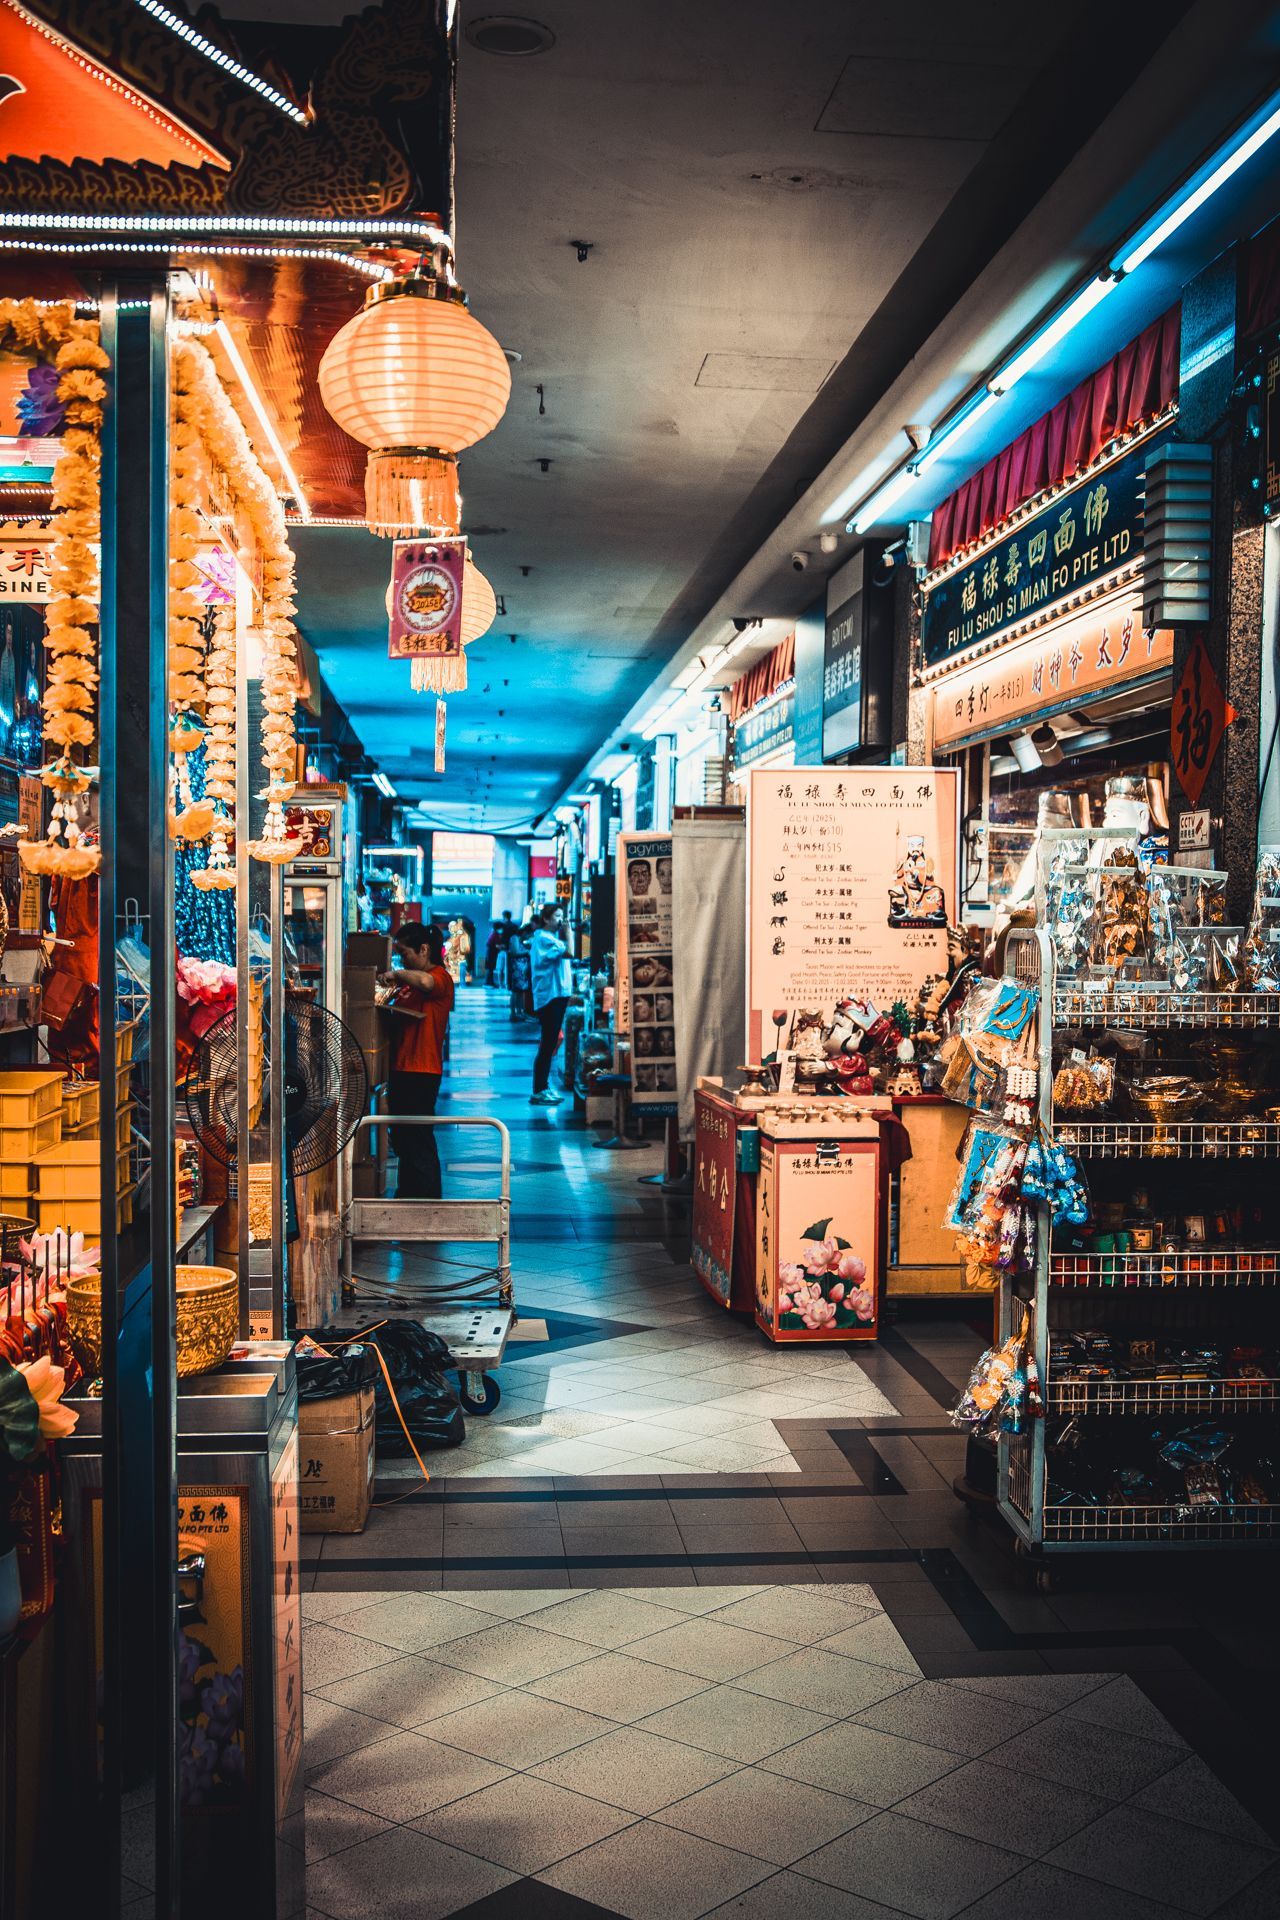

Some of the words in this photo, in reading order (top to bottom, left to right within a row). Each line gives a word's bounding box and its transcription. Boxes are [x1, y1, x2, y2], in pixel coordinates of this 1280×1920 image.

[0, 581, 54, 593] SINE
[948, 628, 960, 649] FU
[961, 620, 973, 641] LU
[976, 603, 1003, 633] SHOU
[1006, 595, 1017, 617] SI
[1020, 576, 1048, 610] MIAN
[1052, 565, 1068, 592] FO
[1073, 546, 1099, 580] PTE
[1104, 529, 1130, 563] LTD
[1177, 645, 1213, 775] 福
[1181, 816, 1195, 828] CCTV
[698, 1152, 729, 1212] 大伯公
[185, 1525, 197, 1533] FO
[198, 1525, 213, 1533] PTE
[215, 1525, 229, 1533] LTD
